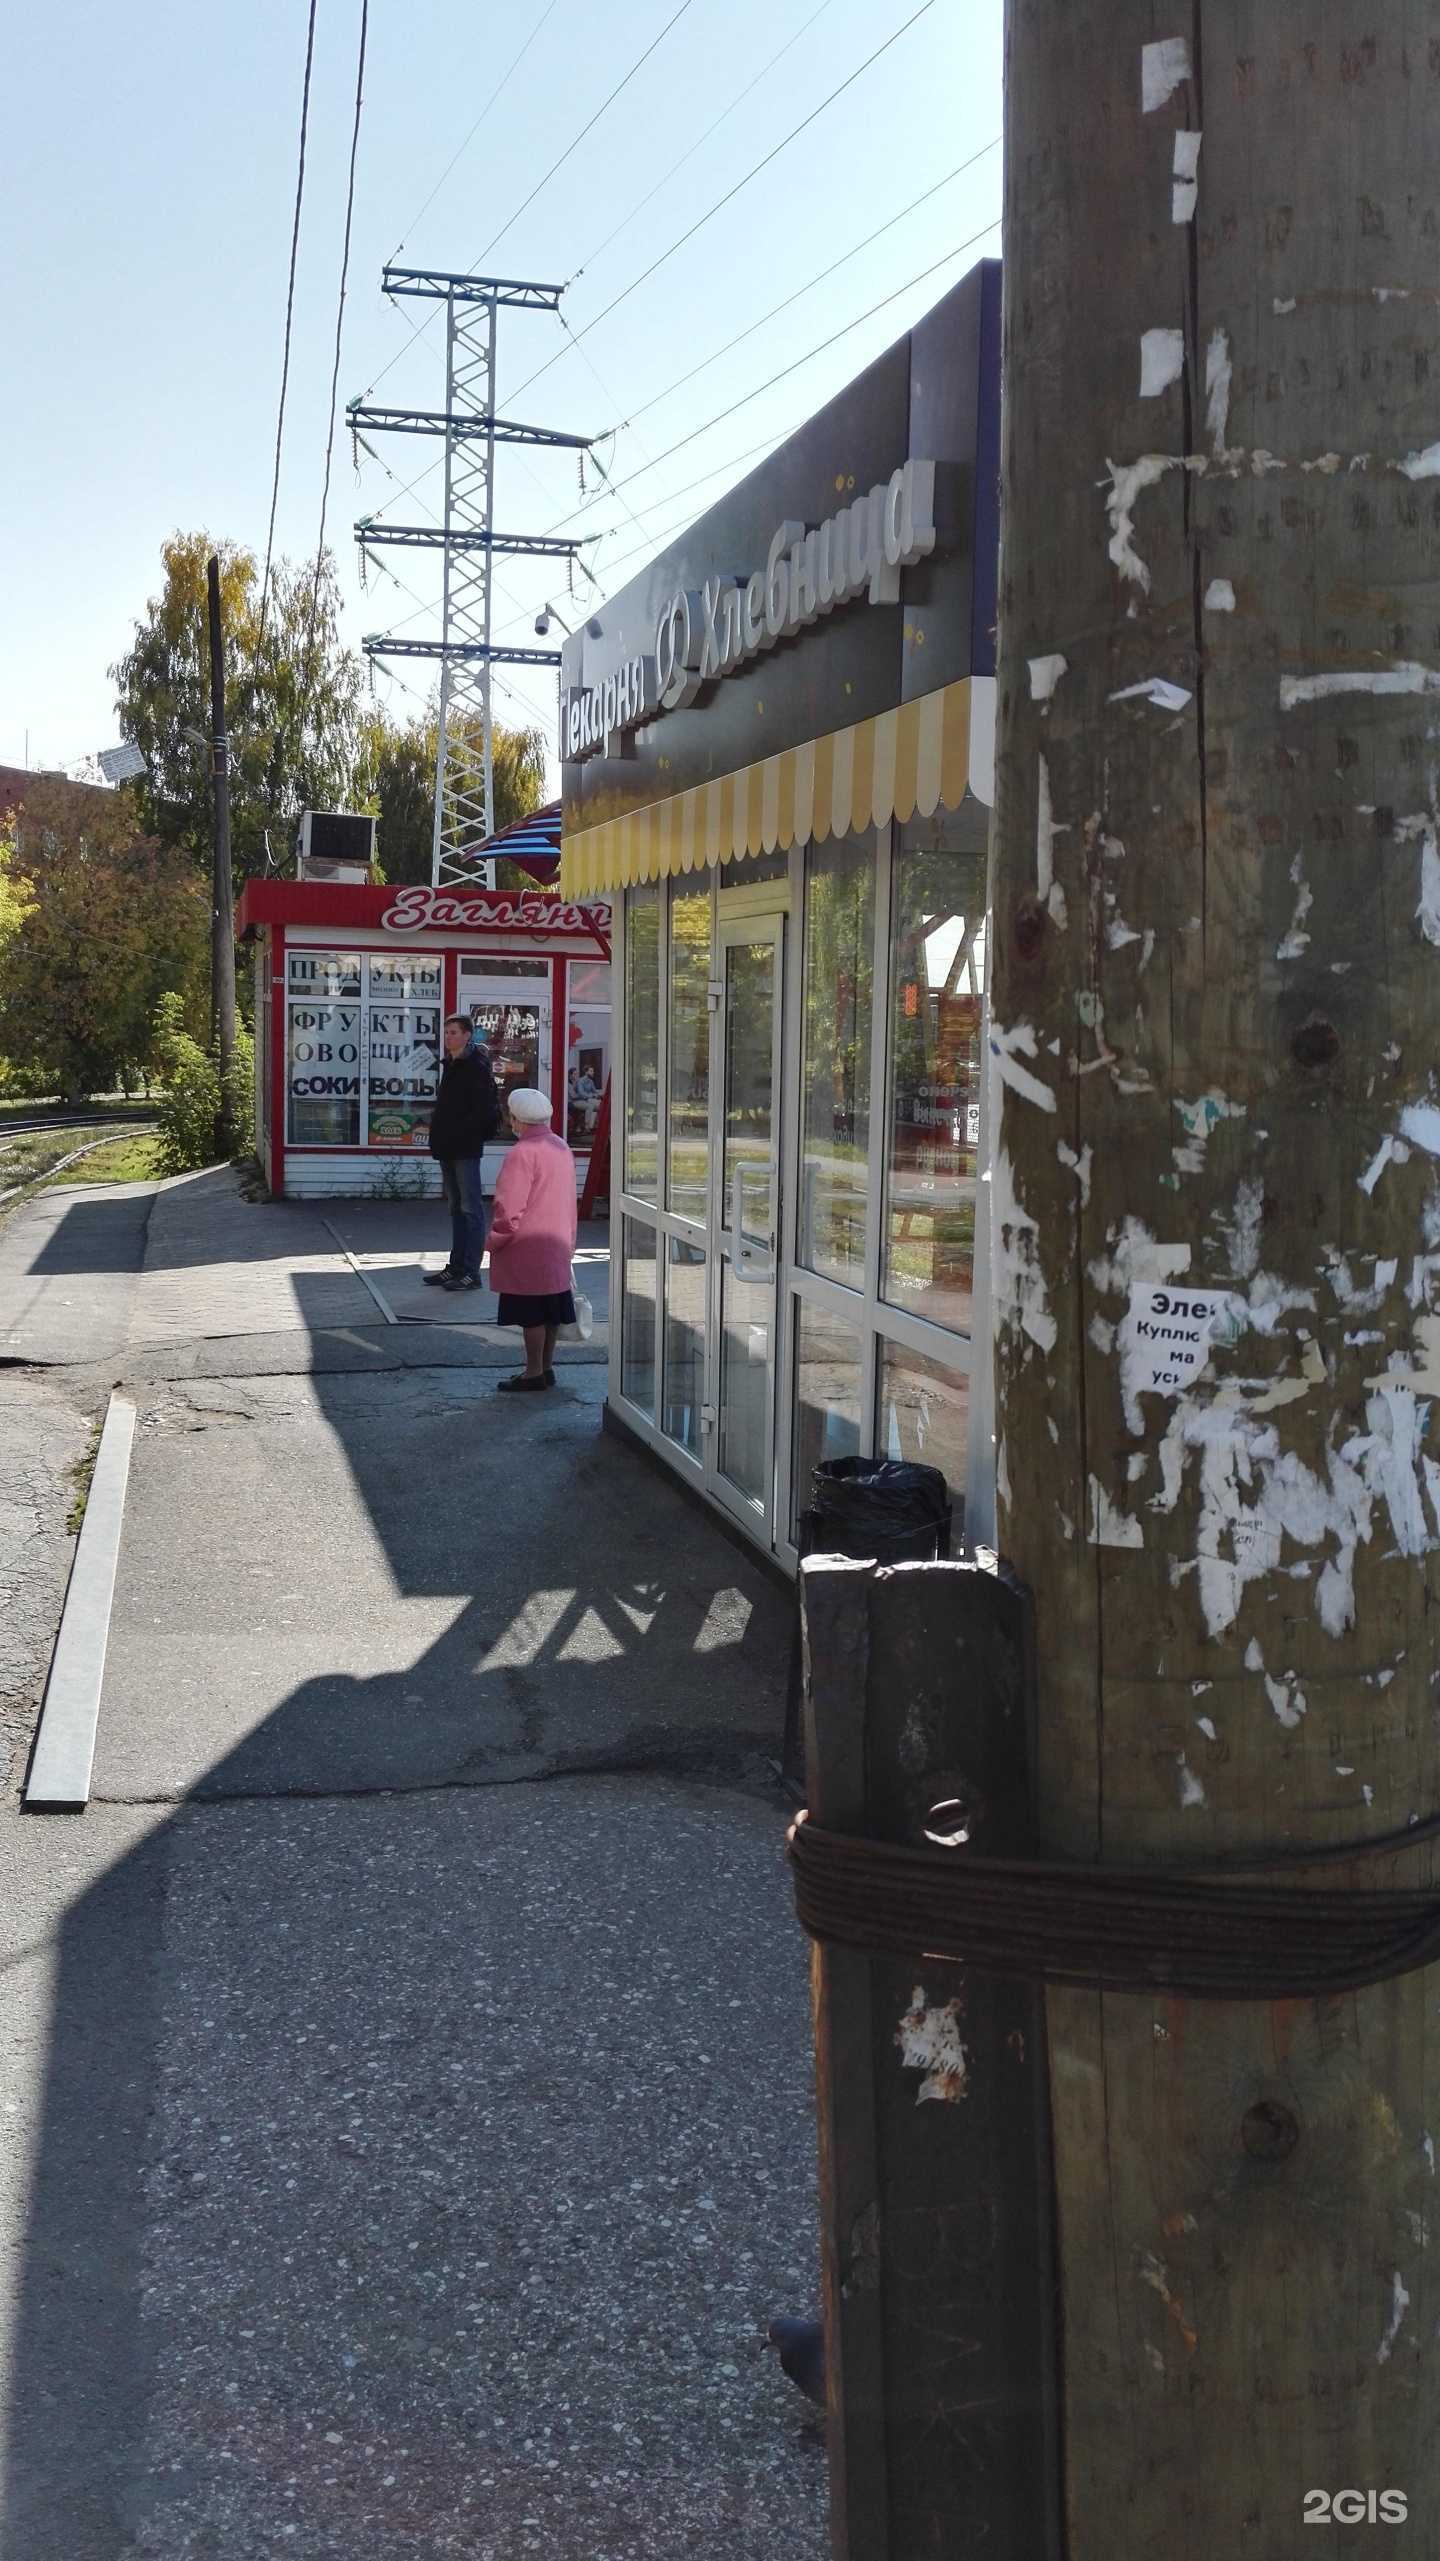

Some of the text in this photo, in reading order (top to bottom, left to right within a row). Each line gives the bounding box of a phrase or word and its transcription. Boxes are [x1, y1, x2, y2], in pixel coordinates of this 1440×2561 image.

[560, 459, 937, 762] Пекарня Хлебница
[294, 1011, 436, 1035] ФРУКТЫ
[292, 1076, 439, 1097] СОКИ ВОДЫ
